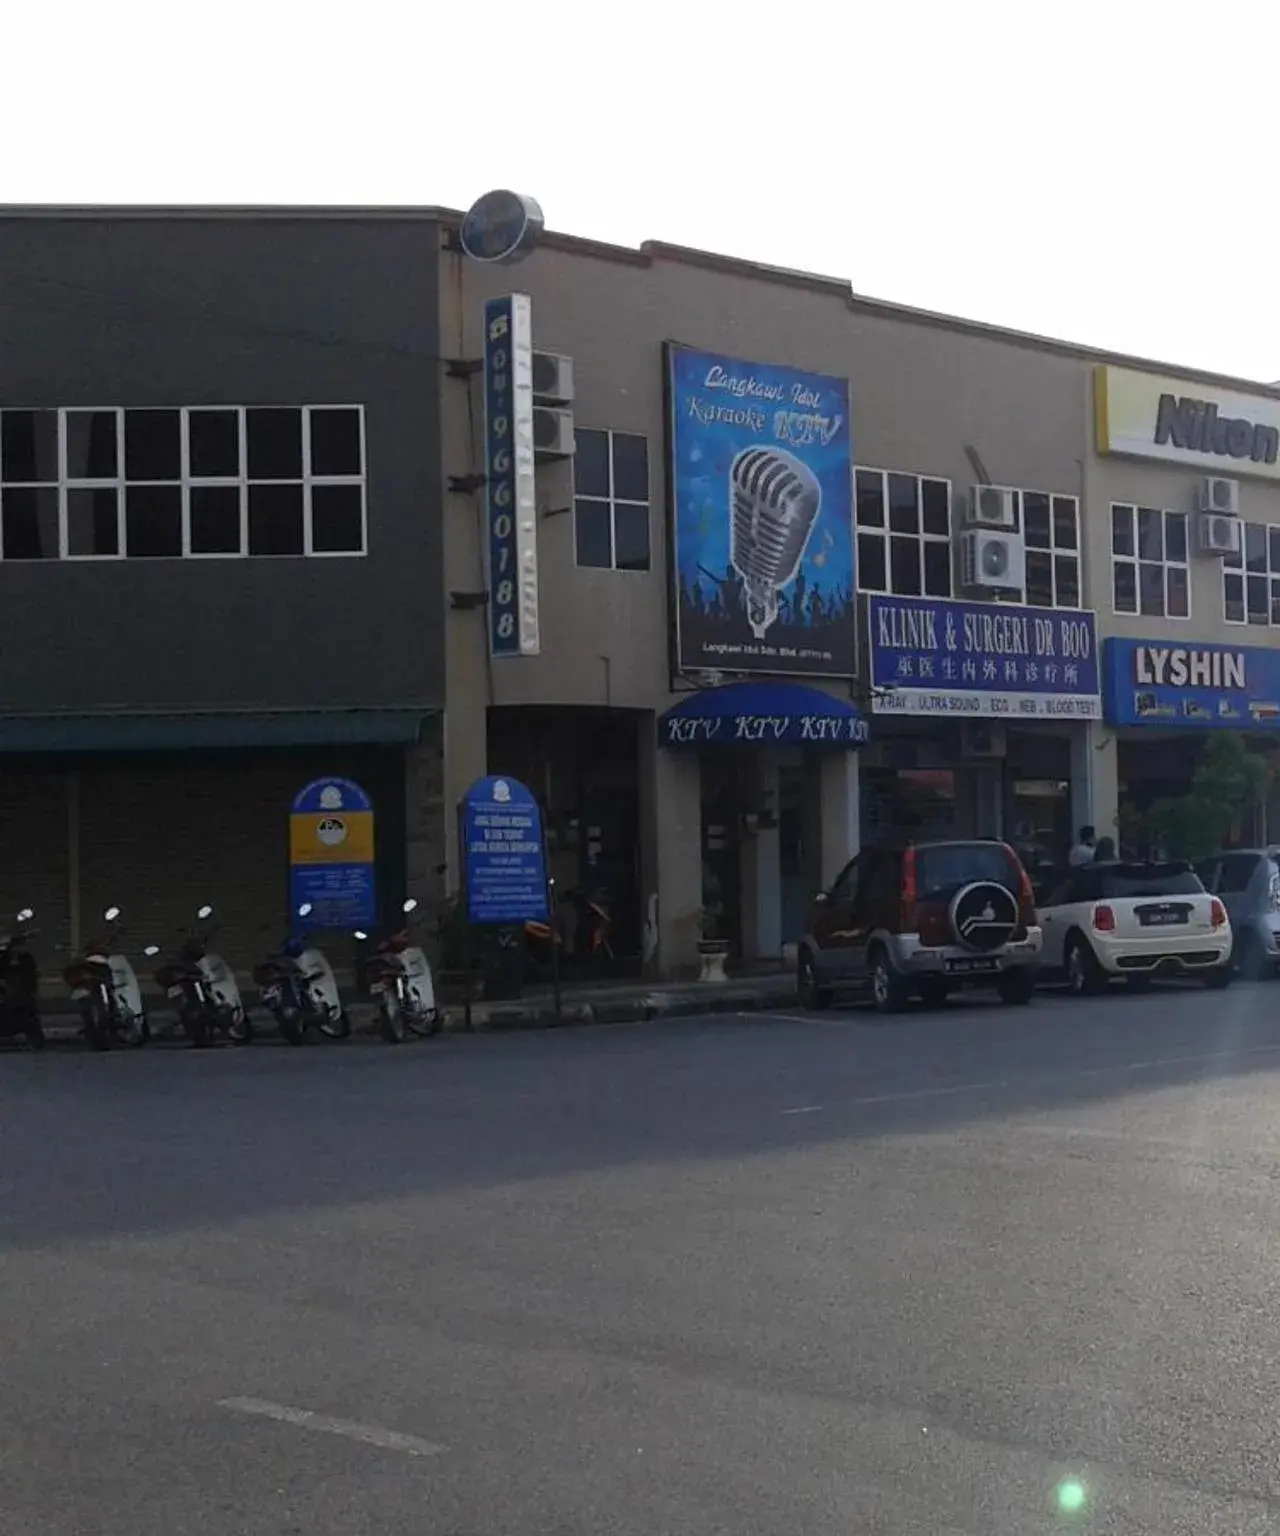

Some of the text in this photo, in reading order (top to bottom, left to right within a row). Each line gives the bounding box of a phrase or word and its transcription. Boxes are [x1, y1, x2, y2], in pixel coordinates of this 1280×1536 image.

[704, 365, 821, 409] Langkawi Idol
[687, 397, 766, 435] Karaoke
[1154, 392, 1280, 465] Nikon
[878, 606, 1090, 659] KLINIK & SURGERI DR BOO
[1135, 647, 1246, 689] LYSHIN
[879, 696, 907, 709] X-RAY
[668, 715, 722, 742] KTV
[734, 714, 789, 740] KTV
[800, 715, 843, 740] KTV
